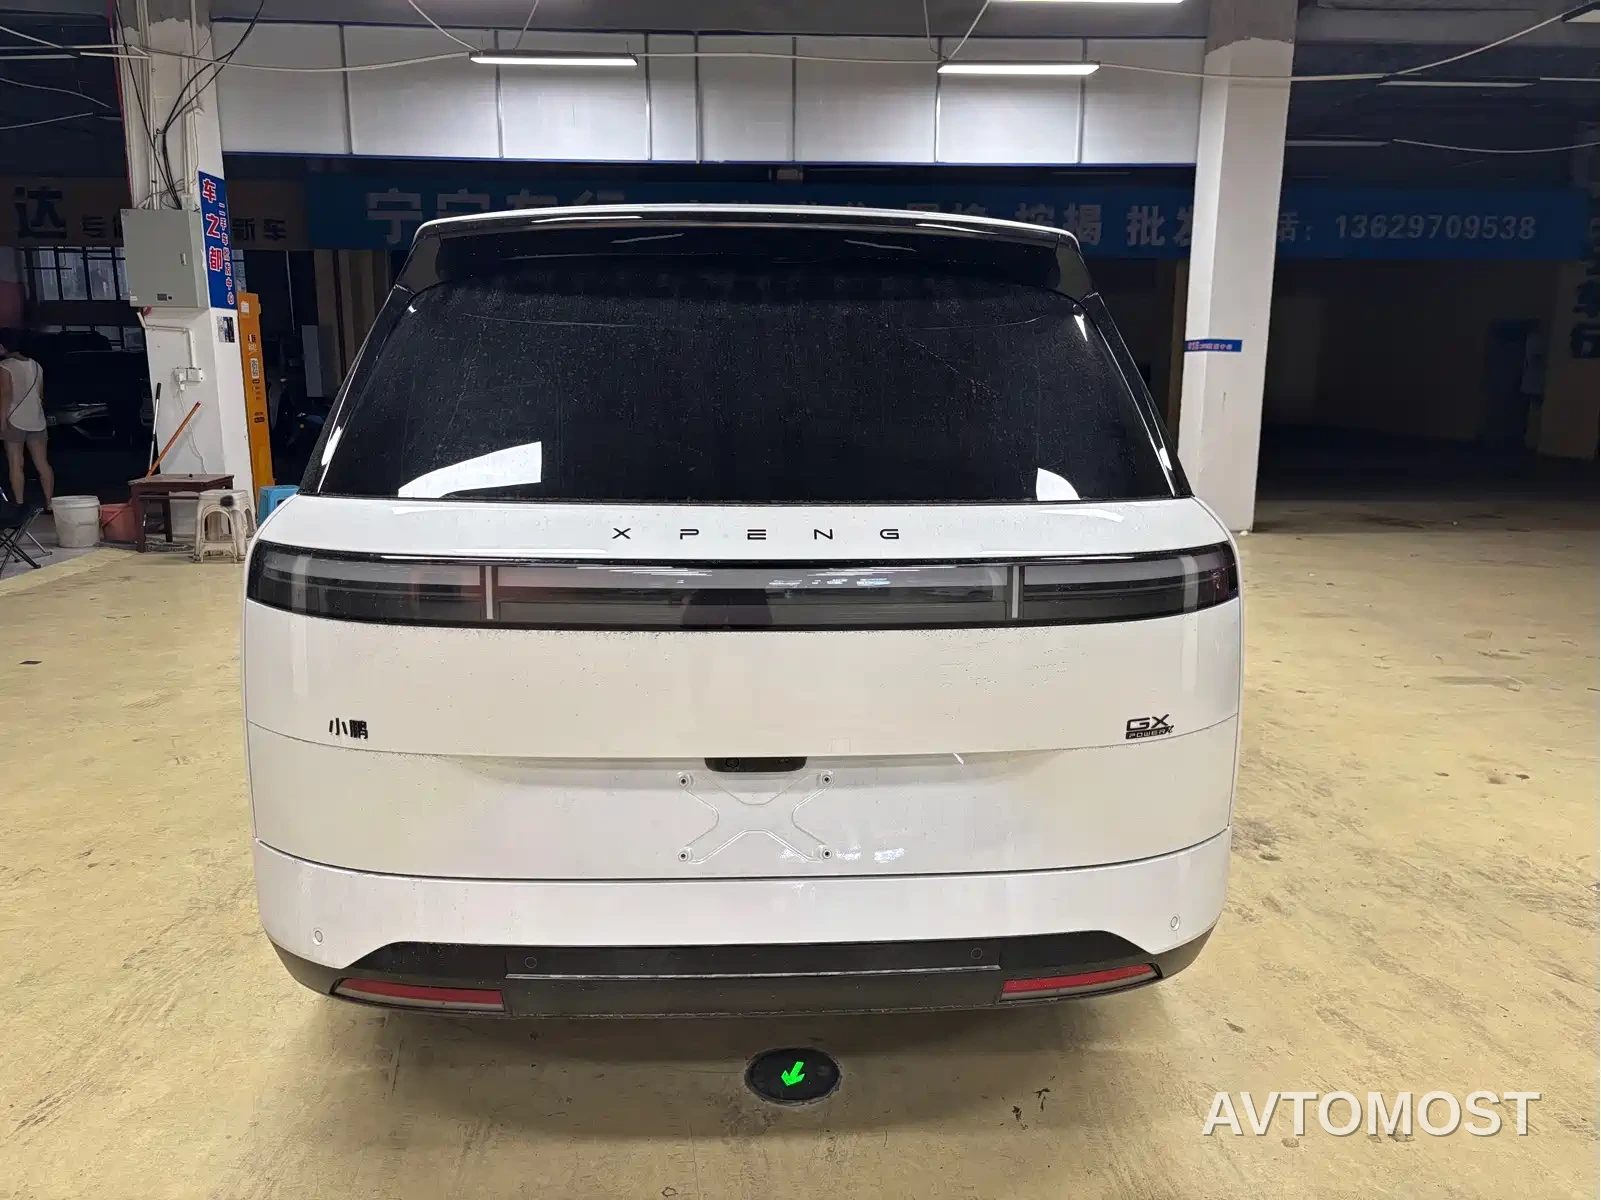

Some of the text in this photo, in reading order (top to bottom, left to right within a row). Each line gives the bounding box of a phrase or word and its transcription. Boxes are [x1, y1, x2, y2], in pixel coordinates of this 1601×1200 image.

[202, 178, 223, 272] 车之都
[1335, 213, 1536, 240] 13629709538
[612, 527, 900, 541] XPENG
[328, 717, 369, 740] 小鹏
[1126, 713, 1170, 732] GX
